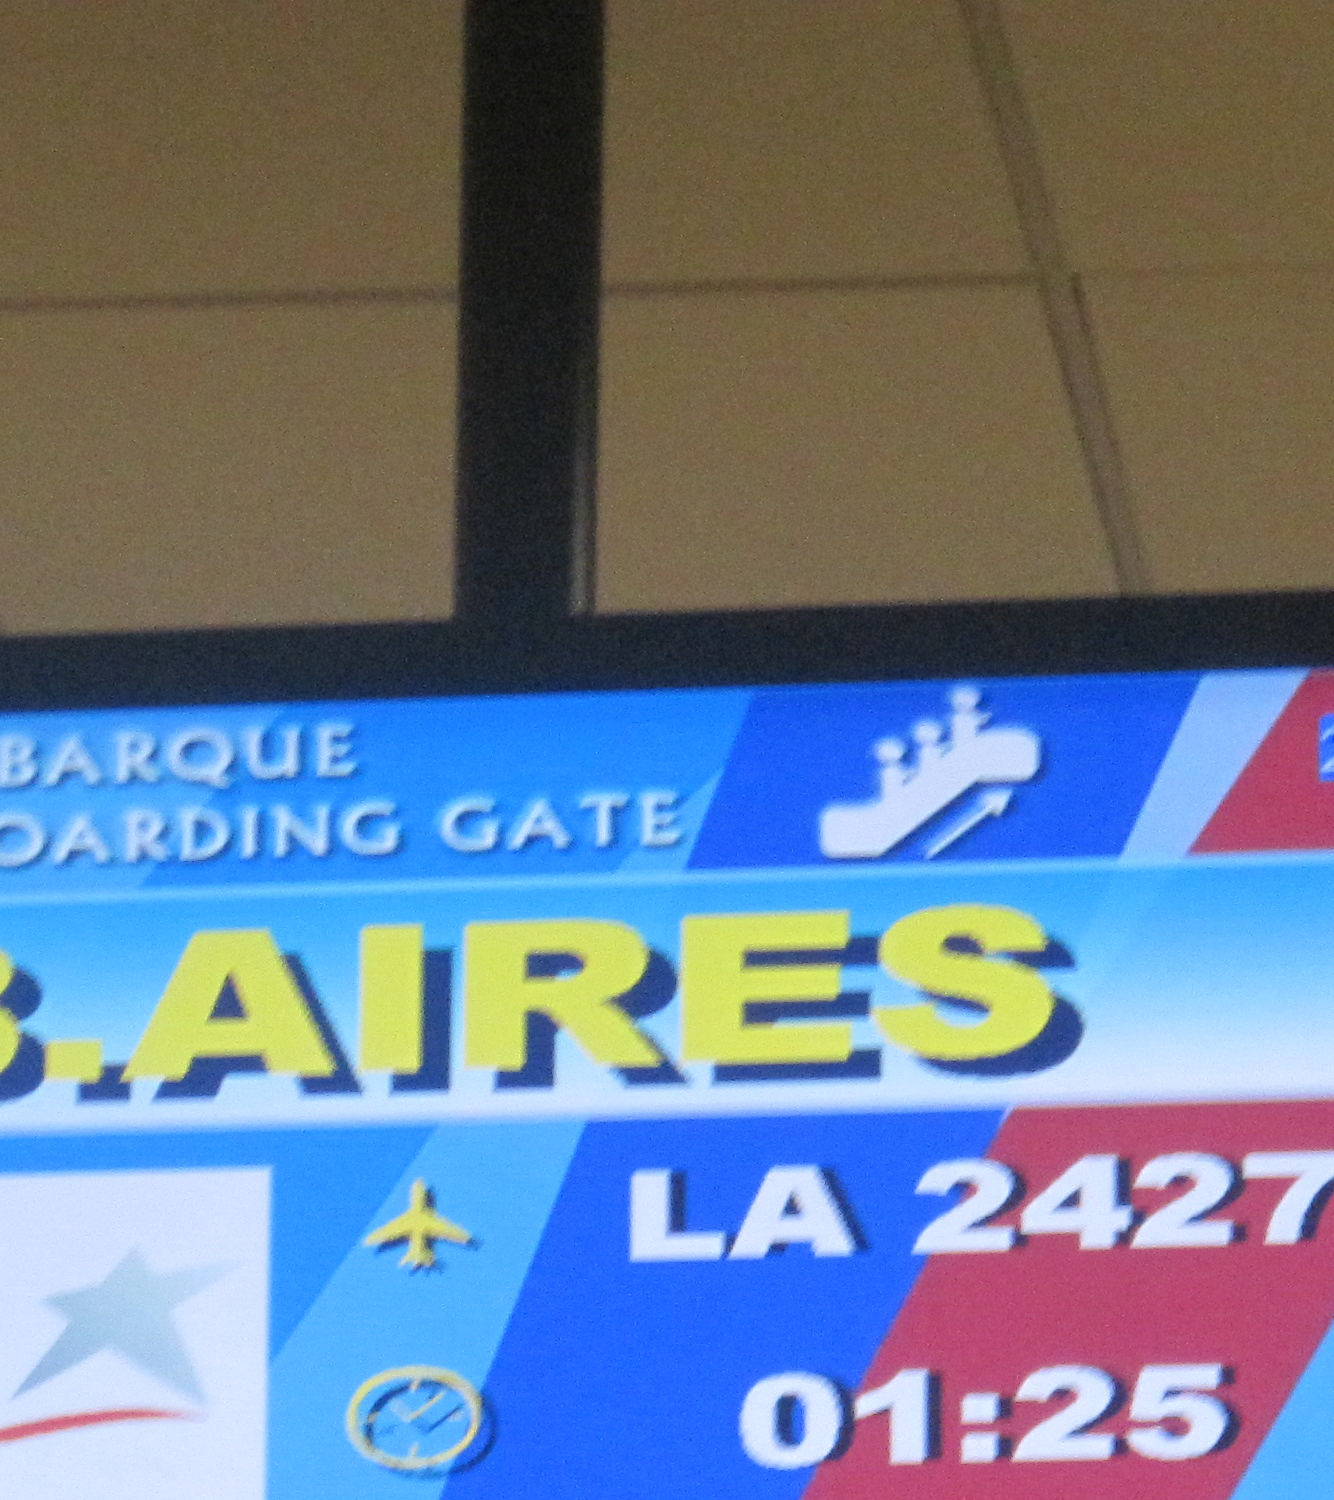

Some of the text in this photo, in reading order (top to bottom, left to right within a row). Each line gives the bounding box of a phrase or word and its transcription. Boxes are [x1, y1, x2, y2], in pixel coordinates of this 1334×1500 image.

[438, 788, 686, 856] GATE
[628, 1163, 861, 1264] LA
[736, 1361, 1235, 1471] 01:25
